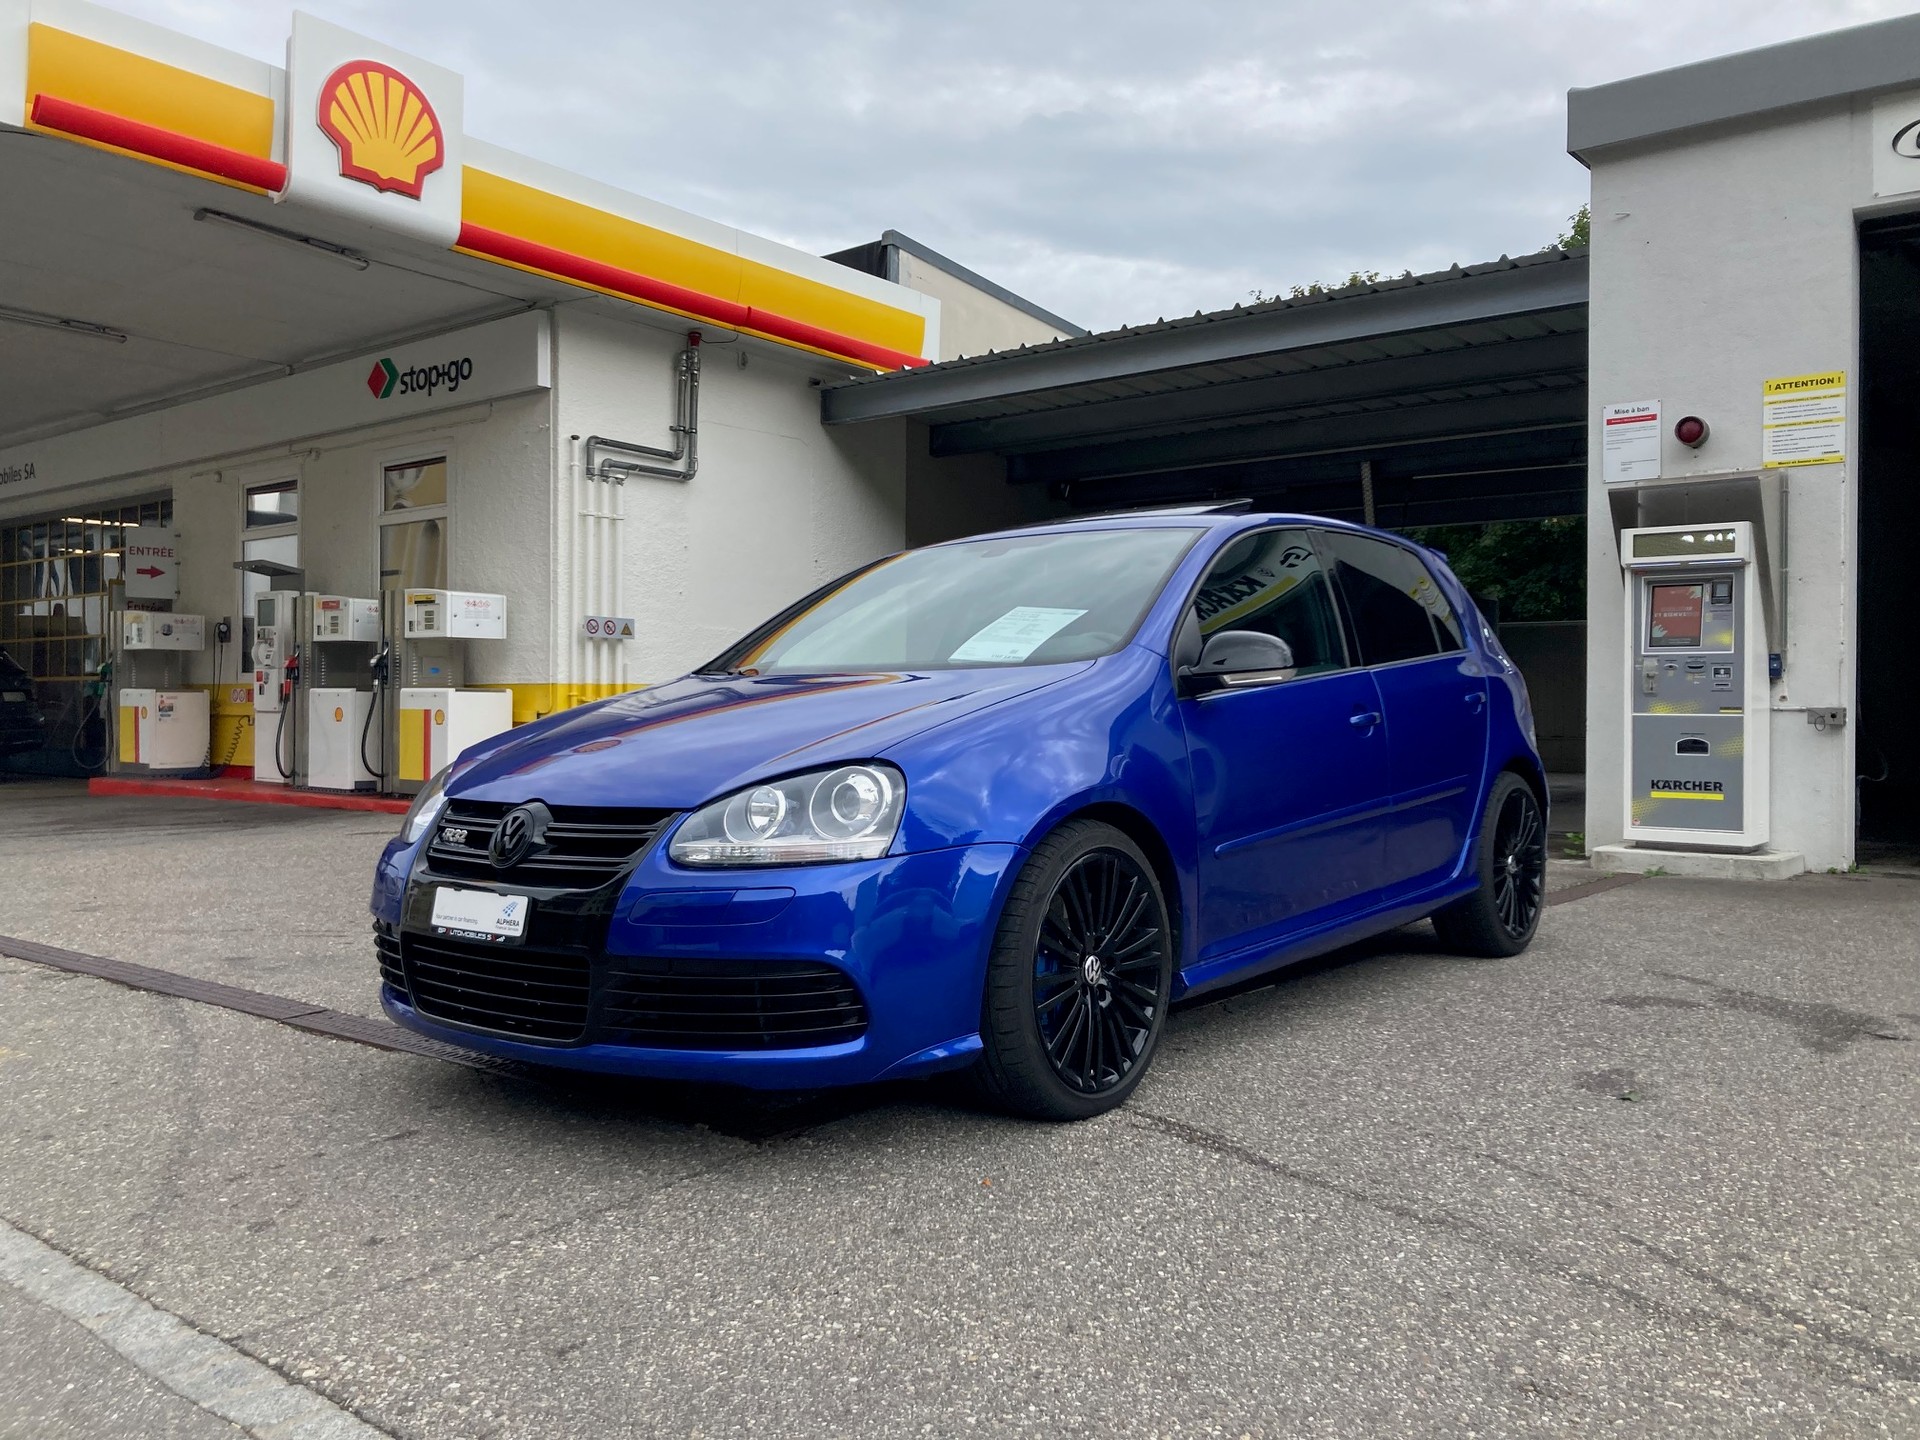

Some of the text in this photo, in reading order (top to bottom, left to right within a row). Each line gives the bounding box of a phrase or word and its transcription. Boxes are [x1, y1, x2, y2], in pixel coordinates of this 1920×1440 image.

[400, 357, 472, 396] stop+go
[1774, 377, 1835, 391] ATTENTION
[24, 462, 36, 480] SA
[129, 546, 174, 558] ENTRÉE
[1651, 779, 1723, 792] KÄRCHER
[496, 918, 520, 927] ALPHERA
